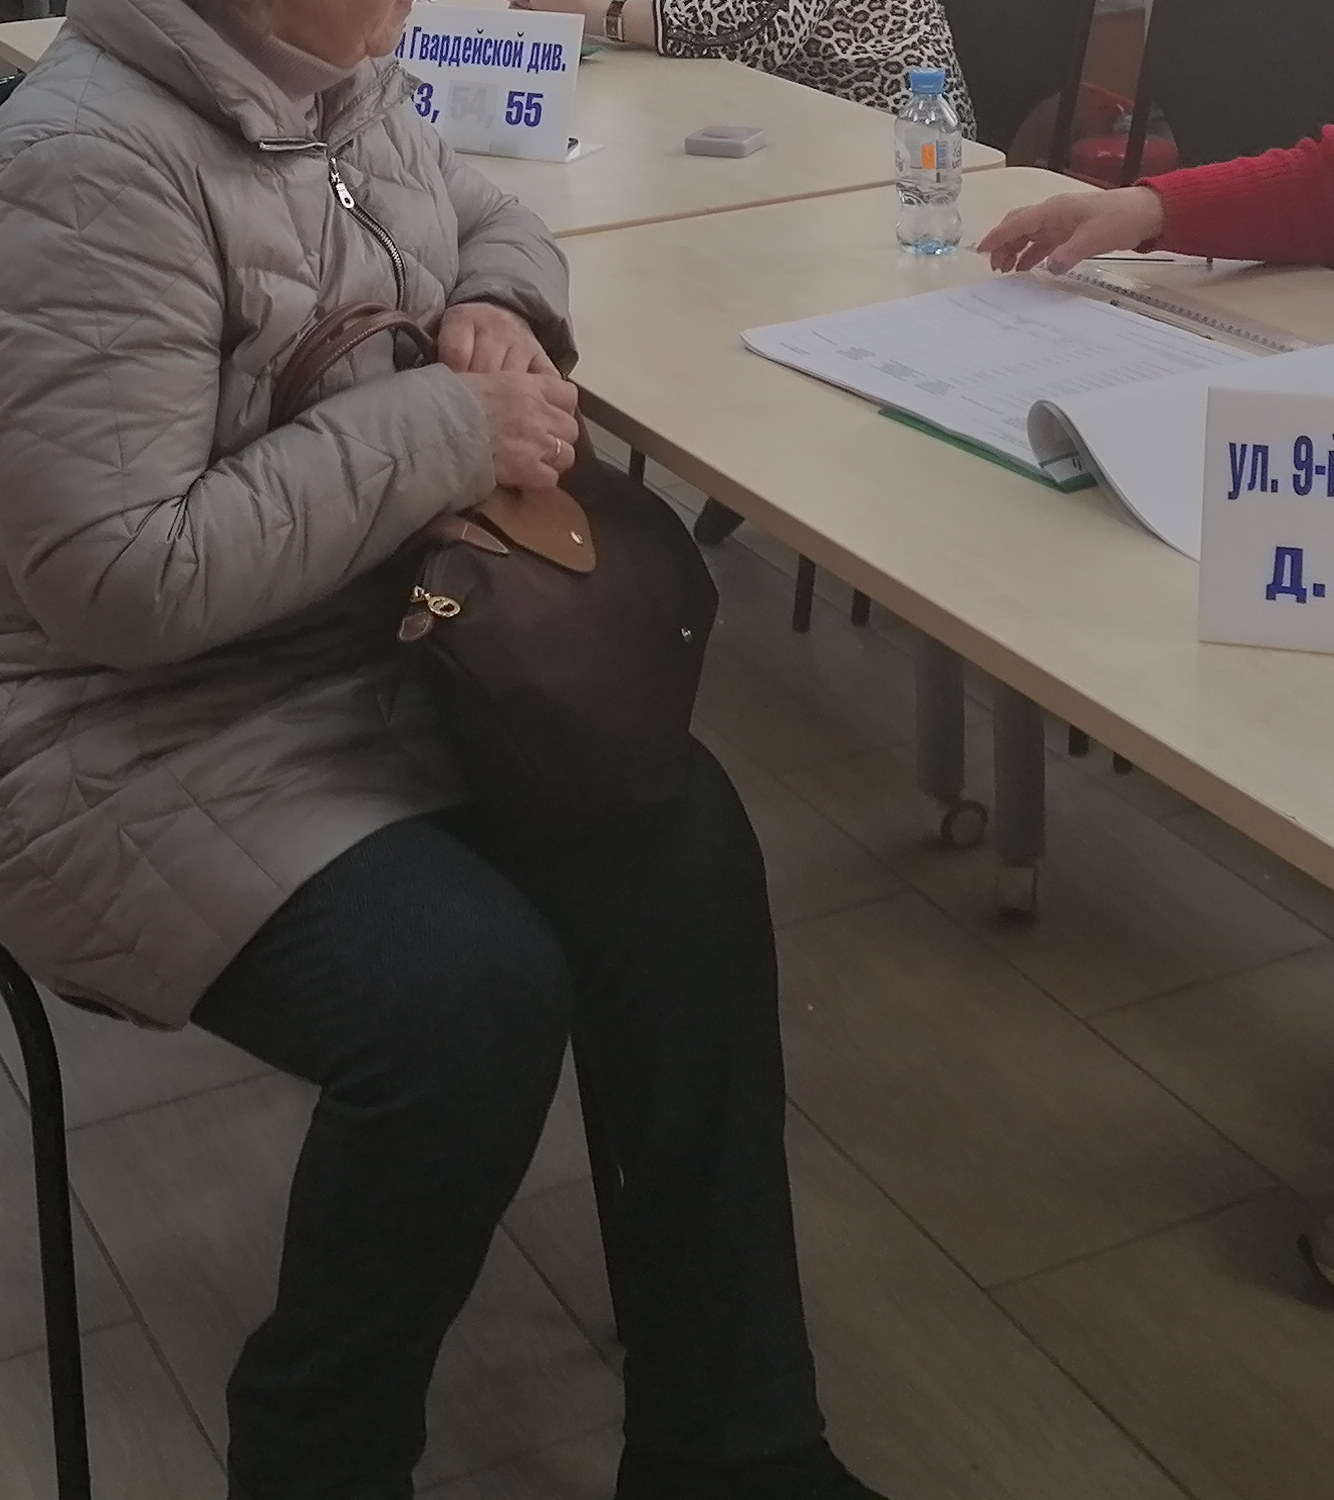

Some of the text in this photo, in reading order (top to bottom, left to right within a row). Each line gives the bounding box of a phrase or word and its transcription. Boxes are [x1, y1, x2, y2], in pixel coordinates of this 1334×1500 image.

[409, 26, 524, 68] Гвардейской
[526, 41, 566, 75] див.
[411, 83, 440, 123] 3,
[505, 90, 544, 127] 55
[1228, 442, 1278, 501] ул.
[1266, 546, 1326, 604] д.
